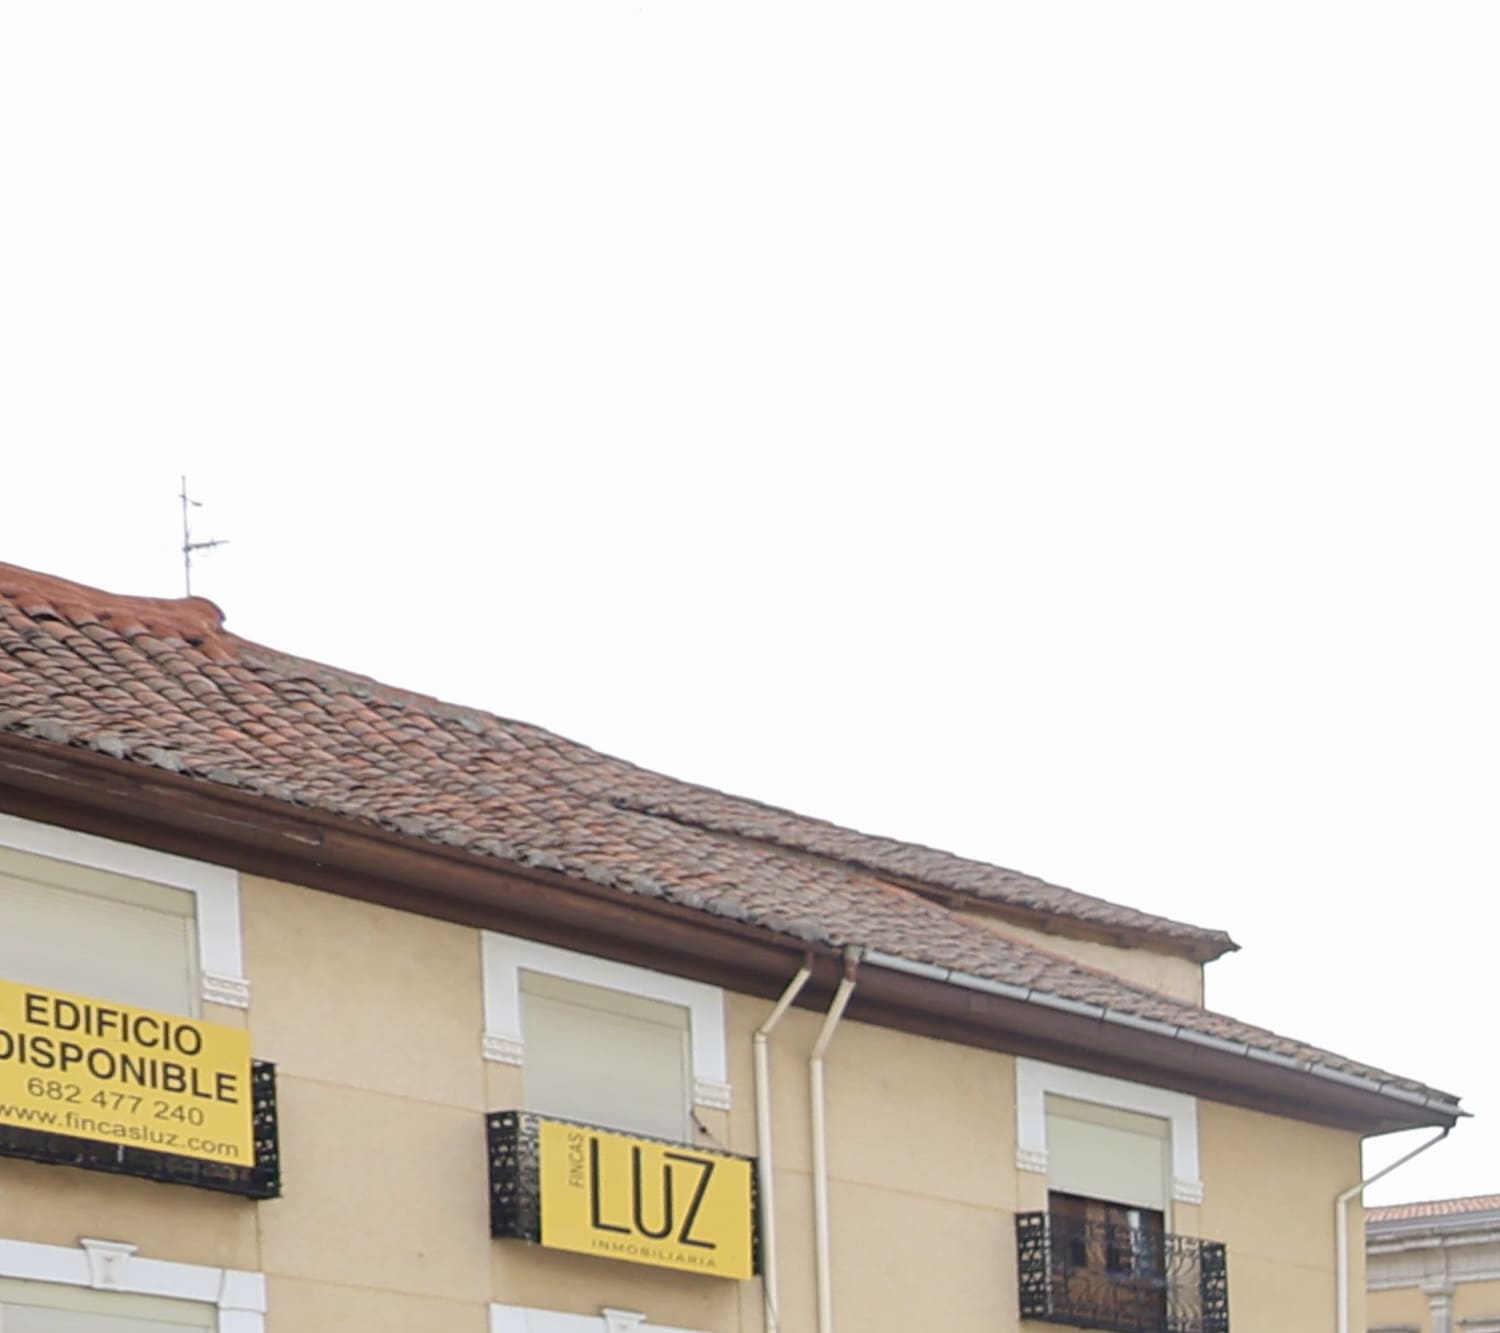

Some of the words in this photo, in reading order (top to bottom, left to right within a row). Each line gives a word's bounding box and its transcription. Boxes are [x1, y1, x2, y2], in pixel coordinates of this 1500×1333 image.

[25, 992, 202, 1056] EDIFICIO
[0, 1029, 239, 1104] DISPONIBLE
[0, 1103, 240, 1158] www.fincasluz.com
[27, 1077, 82, 1104] 682
[91, 1089, 143, 1115] 477
[153, 1100, 205, 1127] 240
[568, 1132, 585, 1189] FINCAS
[589, 1135, 717, 1250] LUZ
[591, 1238, 718, 1269] INMOBILIARIA
